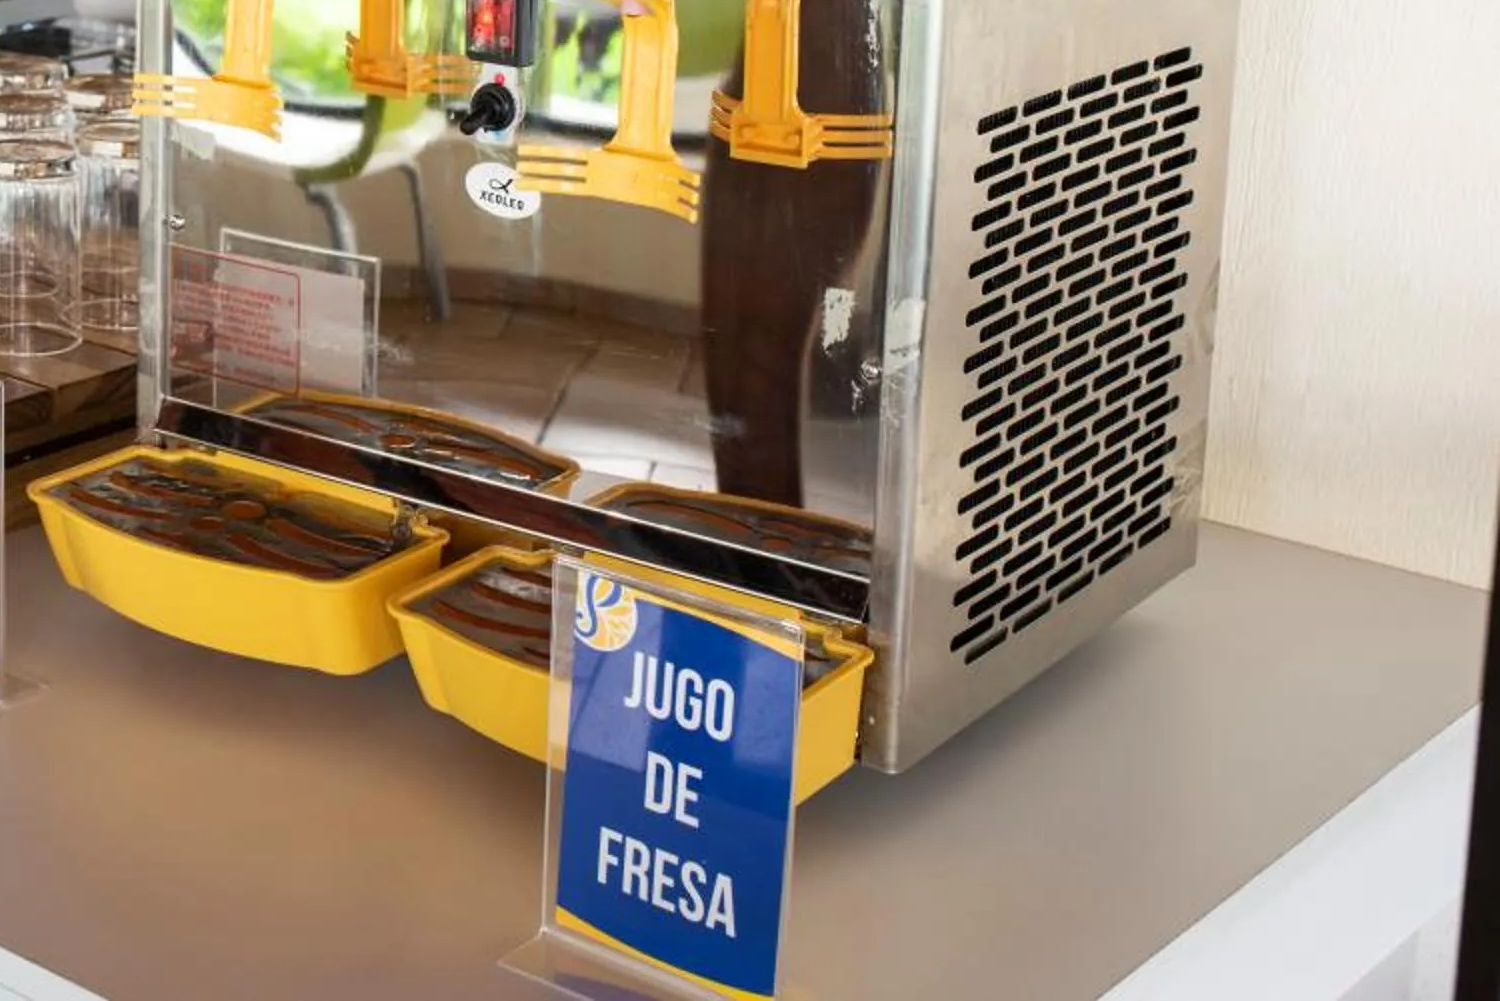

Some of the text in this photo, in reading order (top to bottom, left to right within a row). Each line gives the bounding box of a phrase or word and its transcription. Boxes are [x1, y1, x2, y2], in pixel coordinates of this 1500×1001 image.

[624, 652, 735, 742] JUGO
[643, 751, 703, 829] DE
[597, 827, 736, 938] FRESA
